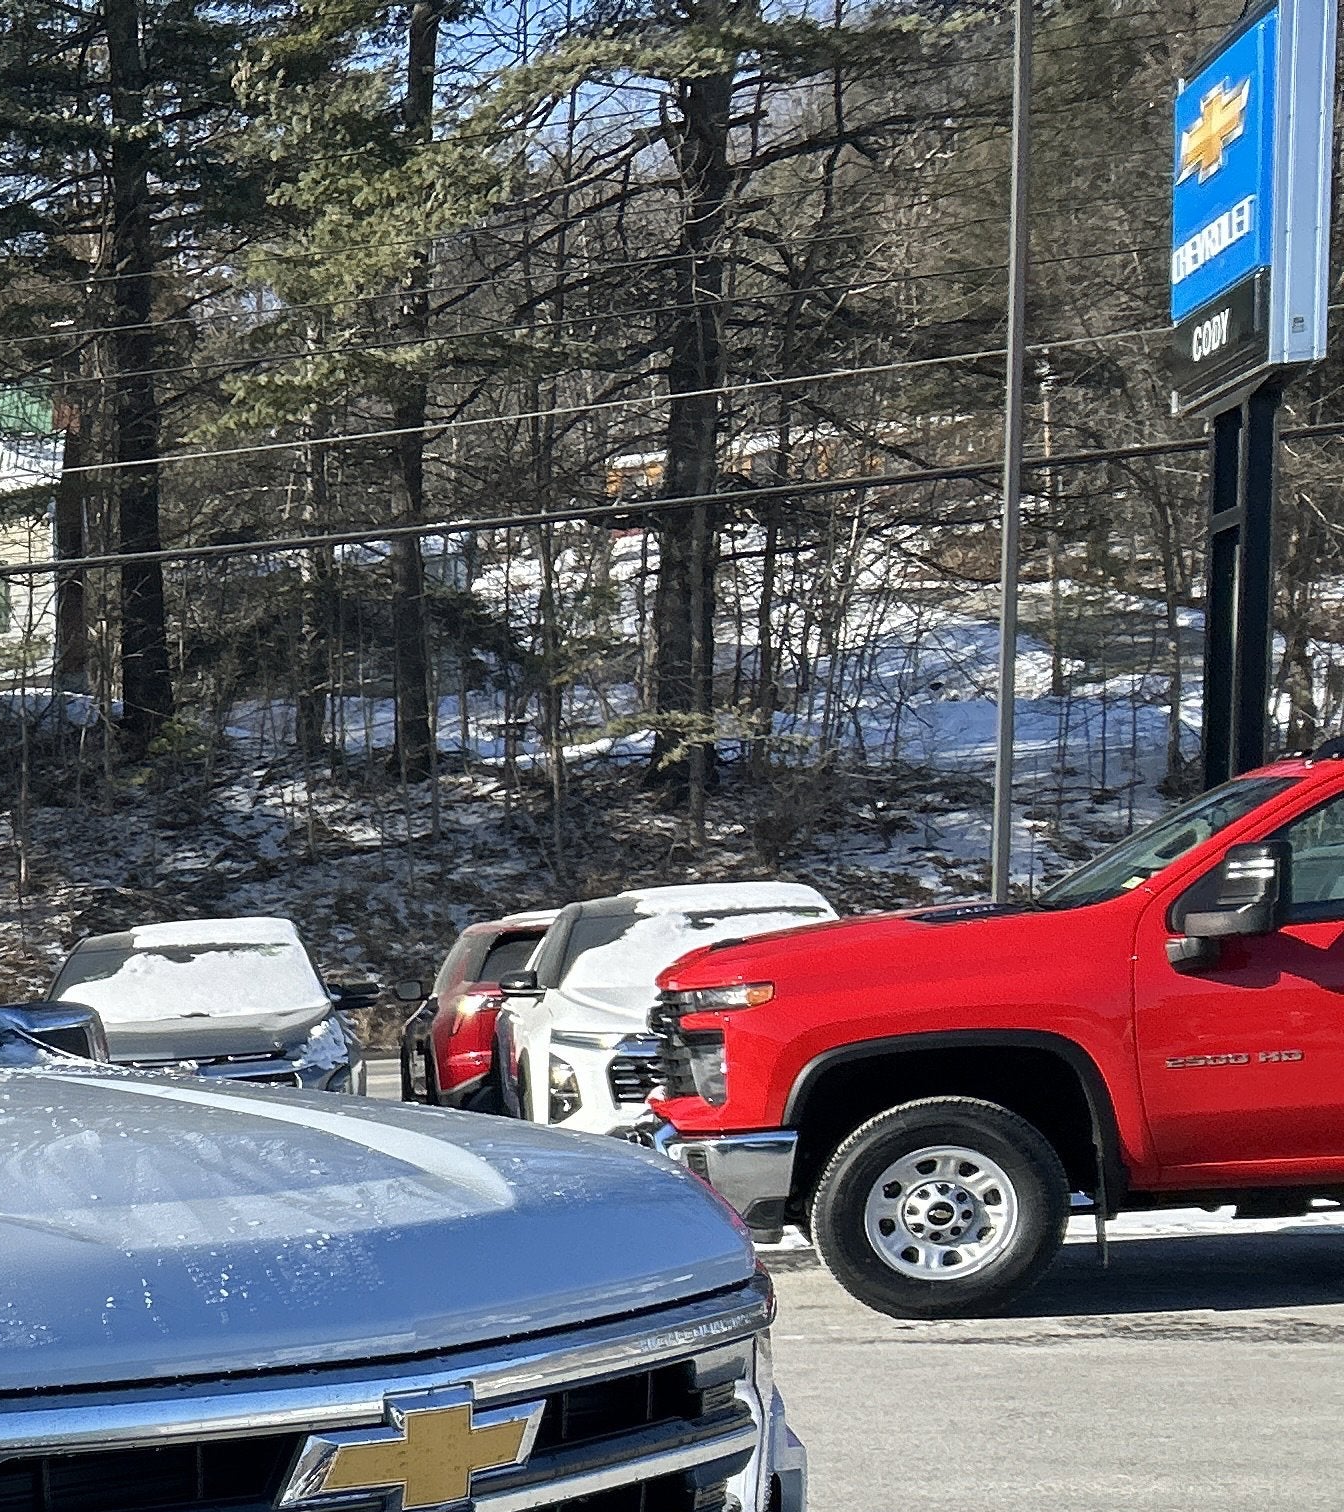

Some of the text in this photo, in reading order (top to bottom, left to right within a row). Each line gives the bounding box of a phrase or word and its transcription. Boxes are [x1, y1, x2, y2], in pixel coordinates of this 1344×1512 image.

[1192, 307, 1231, 362] CODY
[1165, 1049, 1303, 1069] 2500 HD
